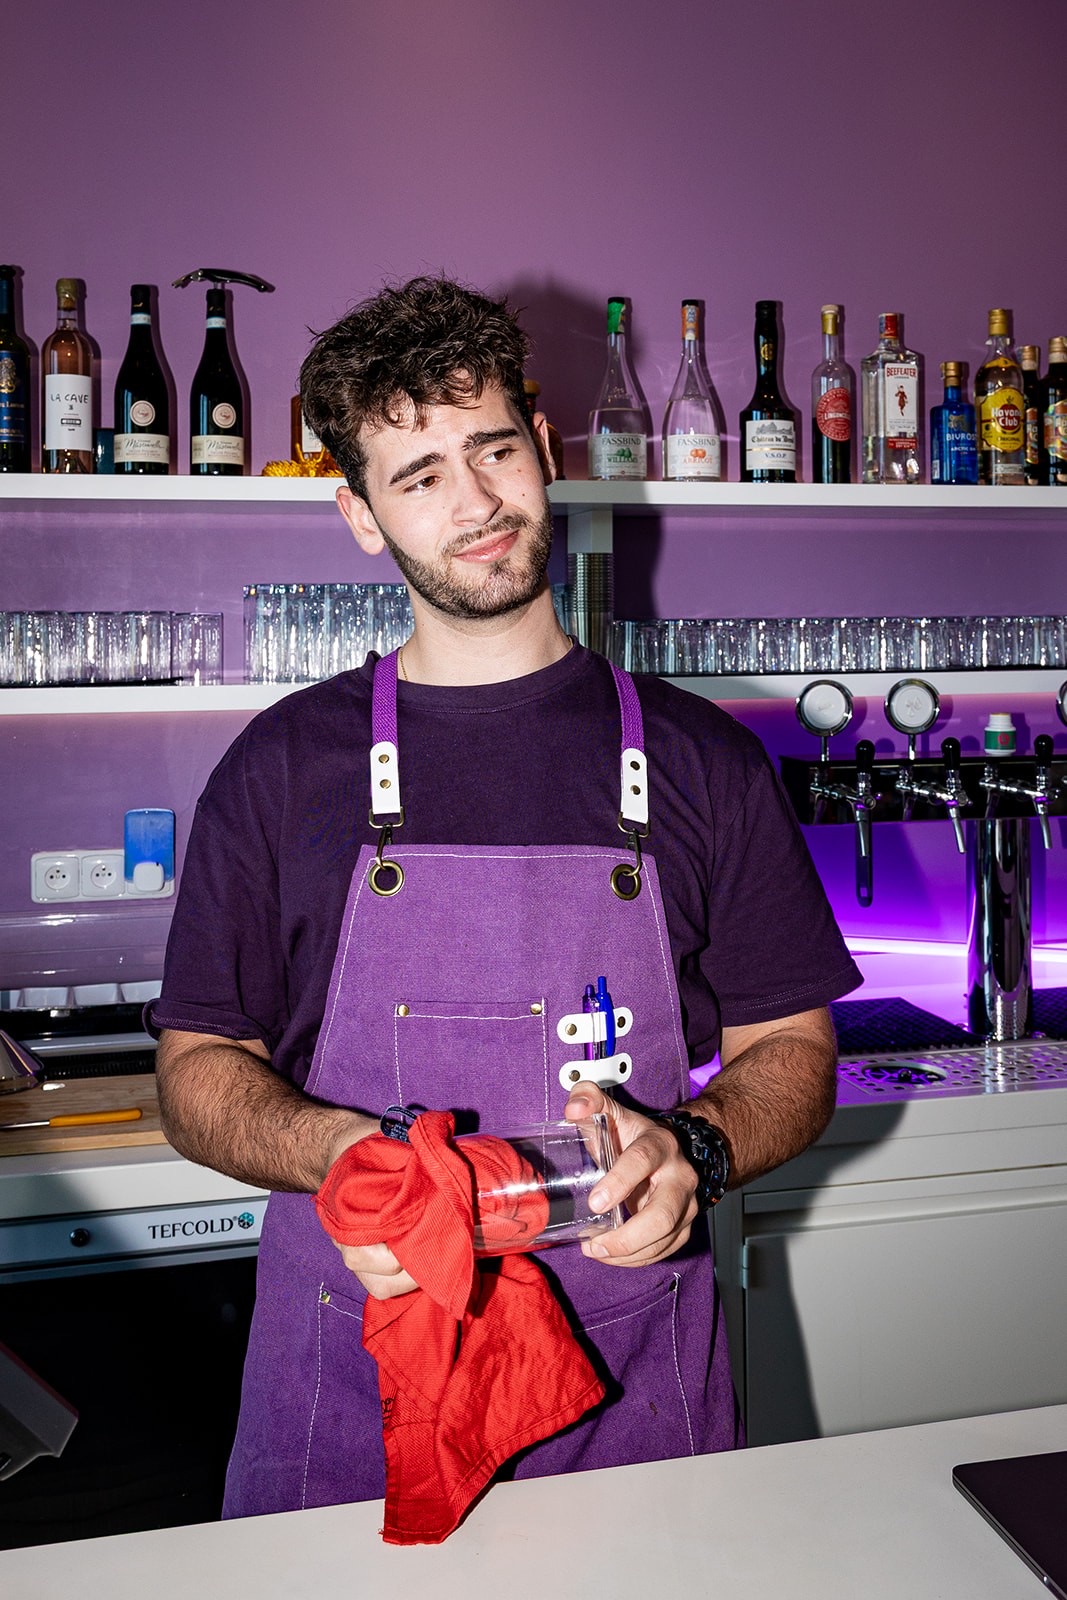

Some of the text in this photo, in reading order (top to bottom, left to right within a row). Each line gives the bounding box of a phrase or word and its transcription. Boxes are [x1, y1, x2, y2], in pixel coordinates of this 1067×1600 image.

[886, 367, 917, 378] BEEFEATER
[50, 393, 89, 404] LA CAVE
[998, 416, 1018, 426] Club
[602, 437, 641, 446] FASSBIND
[677, 437, 716, 447] FASSBIND
[148, 1217, 234, 1240] TEFCOLD
